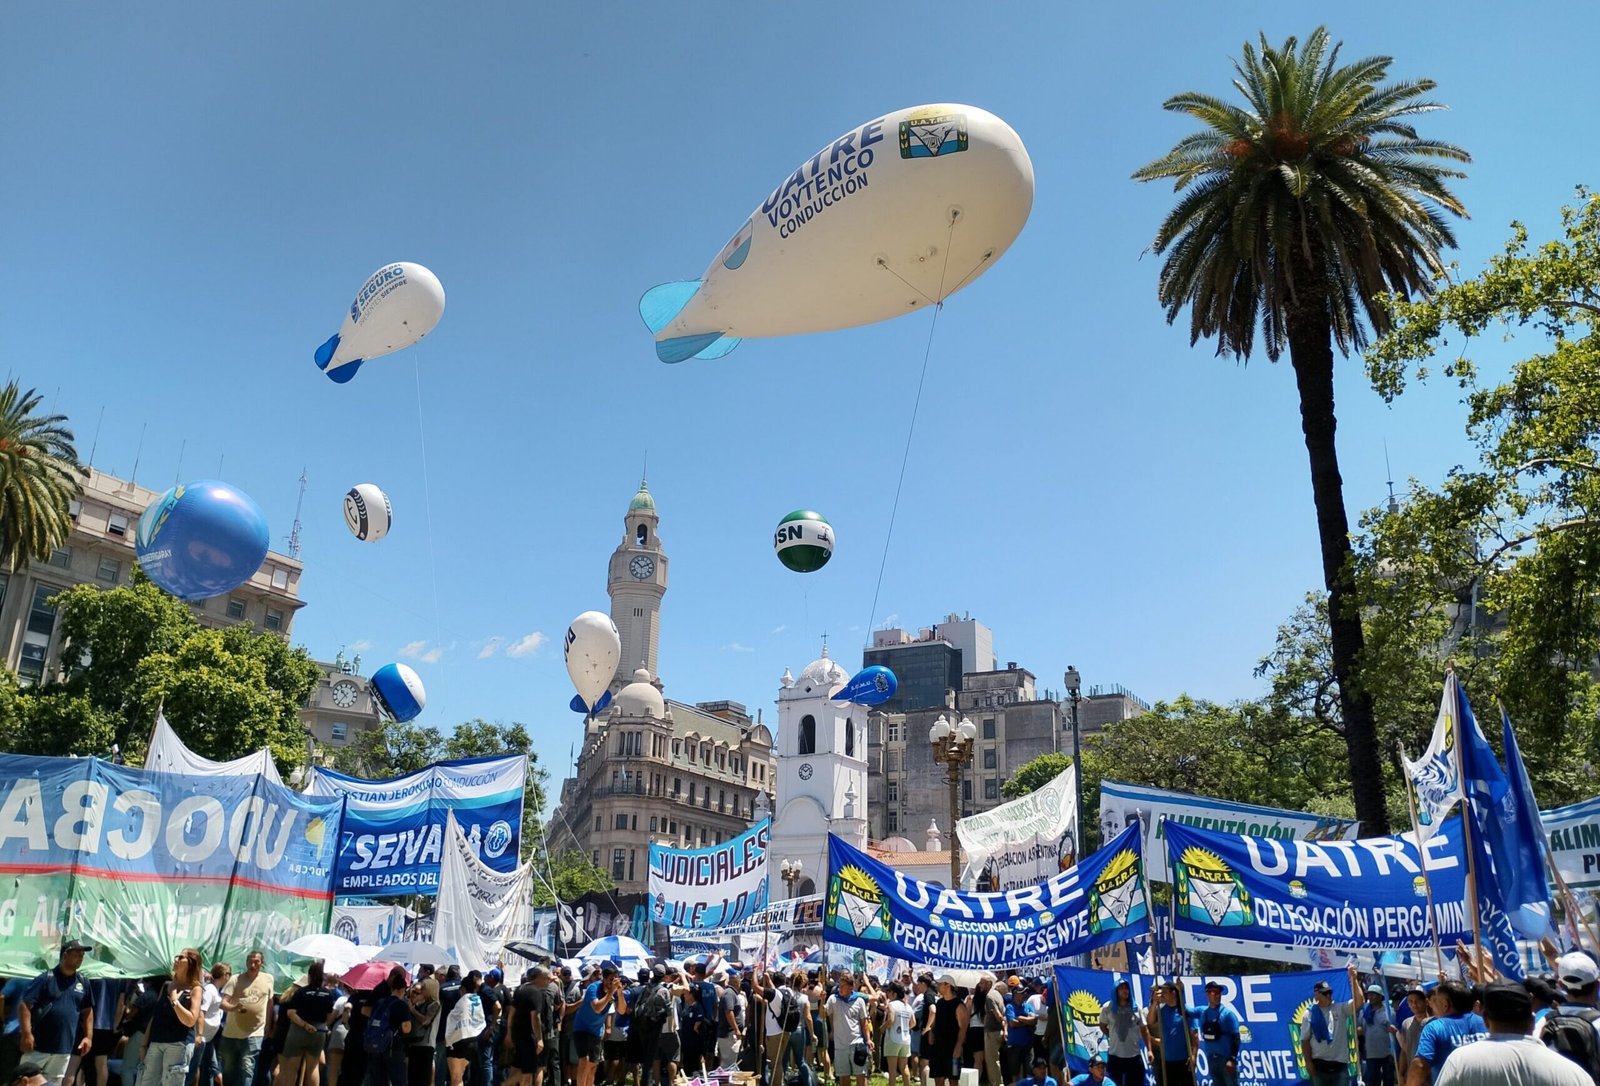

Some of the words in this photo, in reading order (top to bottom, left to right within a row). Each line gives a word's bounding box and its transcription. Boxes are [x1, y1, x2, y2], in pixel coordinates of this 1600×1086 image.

[761, 118, 885, 214] UATRE
[768, 149, 874, 228] VOYTENCO
[779, 172, 868, 239] CONDUCCIÓN
[359, 267, 404, 307] SEGURO
[1155, 813, 1296, 840] AENTACIÓN
[652, 826, 768, 886] JUDICIALES
[1241, 833, 1460, 878] UATRE
[342, 873, 418, 888] EMPLEADOS
[418, 872, 439, 886] DEL
[893, 865, 1085, 919] UATRE
[747, 923, 781, 933] ZELARYAN
[750, 910, 789, 926] LABORAL
[893, 918, 999, 963] PERGAMINO
[1002, 909, 1089, 960] PRESENTE
[948, 919, 1013, 934] SECCIONAL
[1015, 917, 1035, 931] 494
[1254, 900, 1370, 938] DELEGACIÓN
[1374, 901, 1465, 939] PERGAMIN
[1113, 972, 1278, 1023] UTRE
[1238, 1050, 1297, 1079] SENTE
